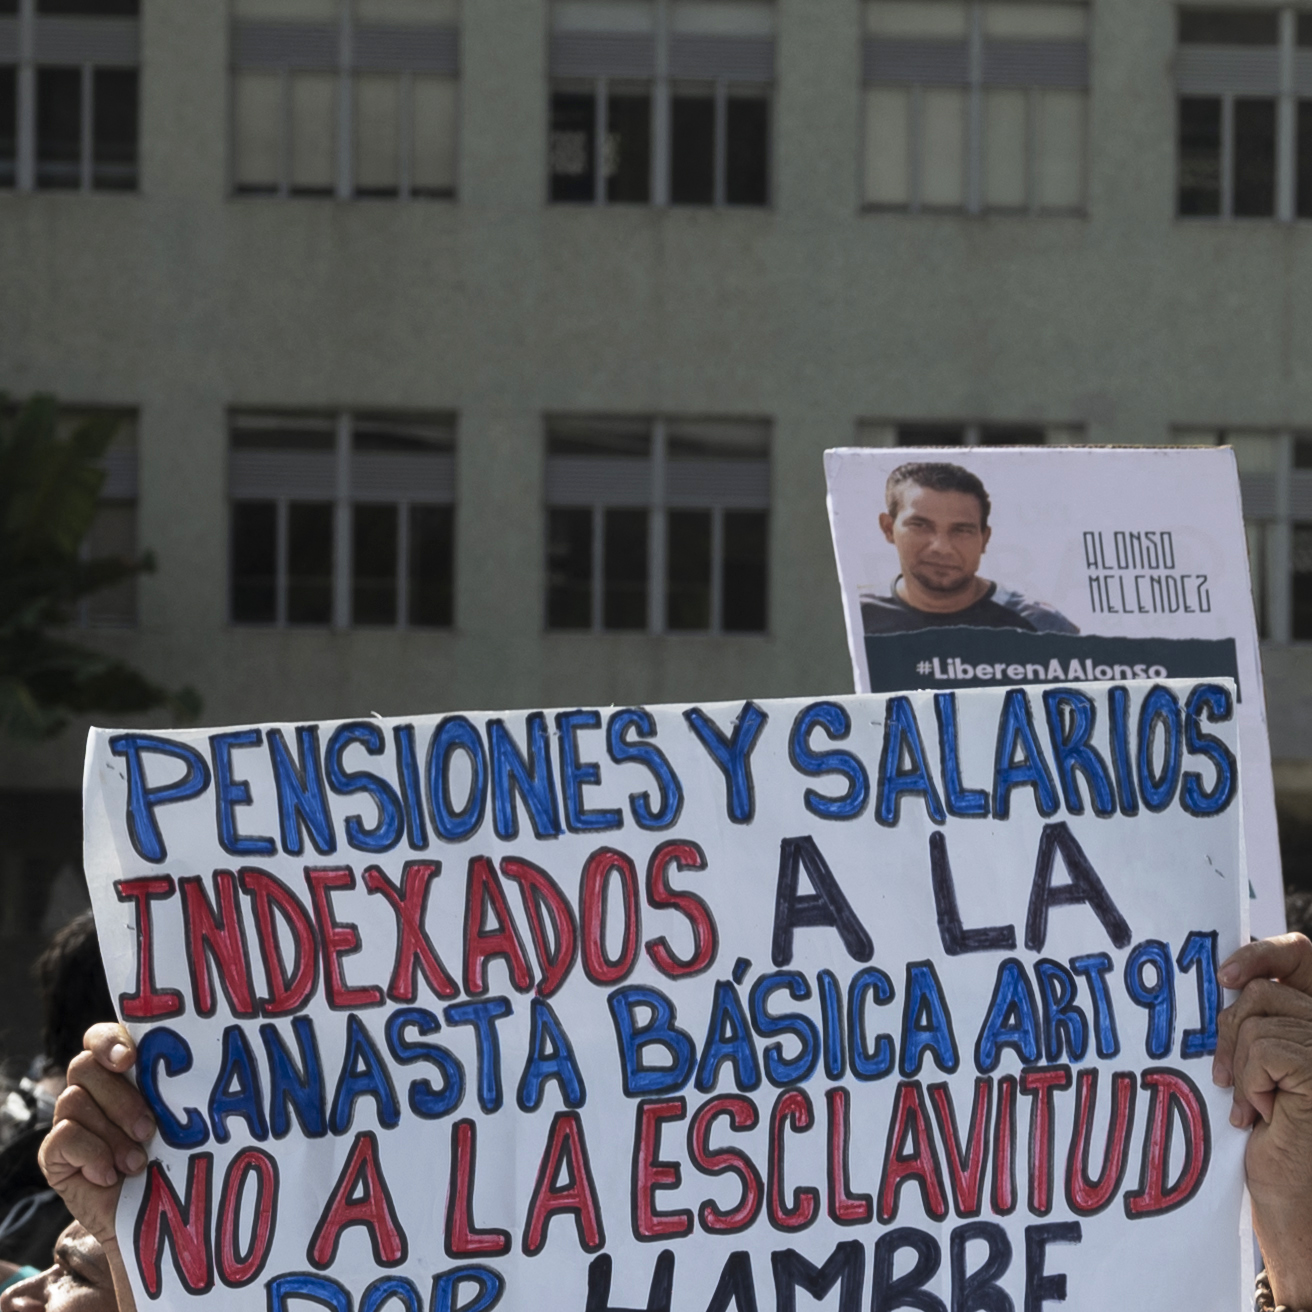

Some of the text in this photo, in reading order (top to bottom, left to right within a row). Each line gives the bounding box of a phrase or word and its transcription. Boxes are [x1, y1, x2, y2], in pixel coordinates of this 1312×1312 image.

[1083, 531, 1175, 570] ALONSO
[1088, 574, 1211, 613] MELENDEZ
[916, 656, 1168, 682] #LiberenAAlonso
[110, 683, 1239, 862] PENSIONES Y SALARIOS
[115, 822, 1131, 1018] INDEXADOS A LA
[136, 997, 586, 1149] CANASTA
[608, 958, 959, 1098] BÁSICA
[975, 954, 1113, 1074] ART
[136, 1067, 1213, 1299] NO A LA ESCLAVITUD
